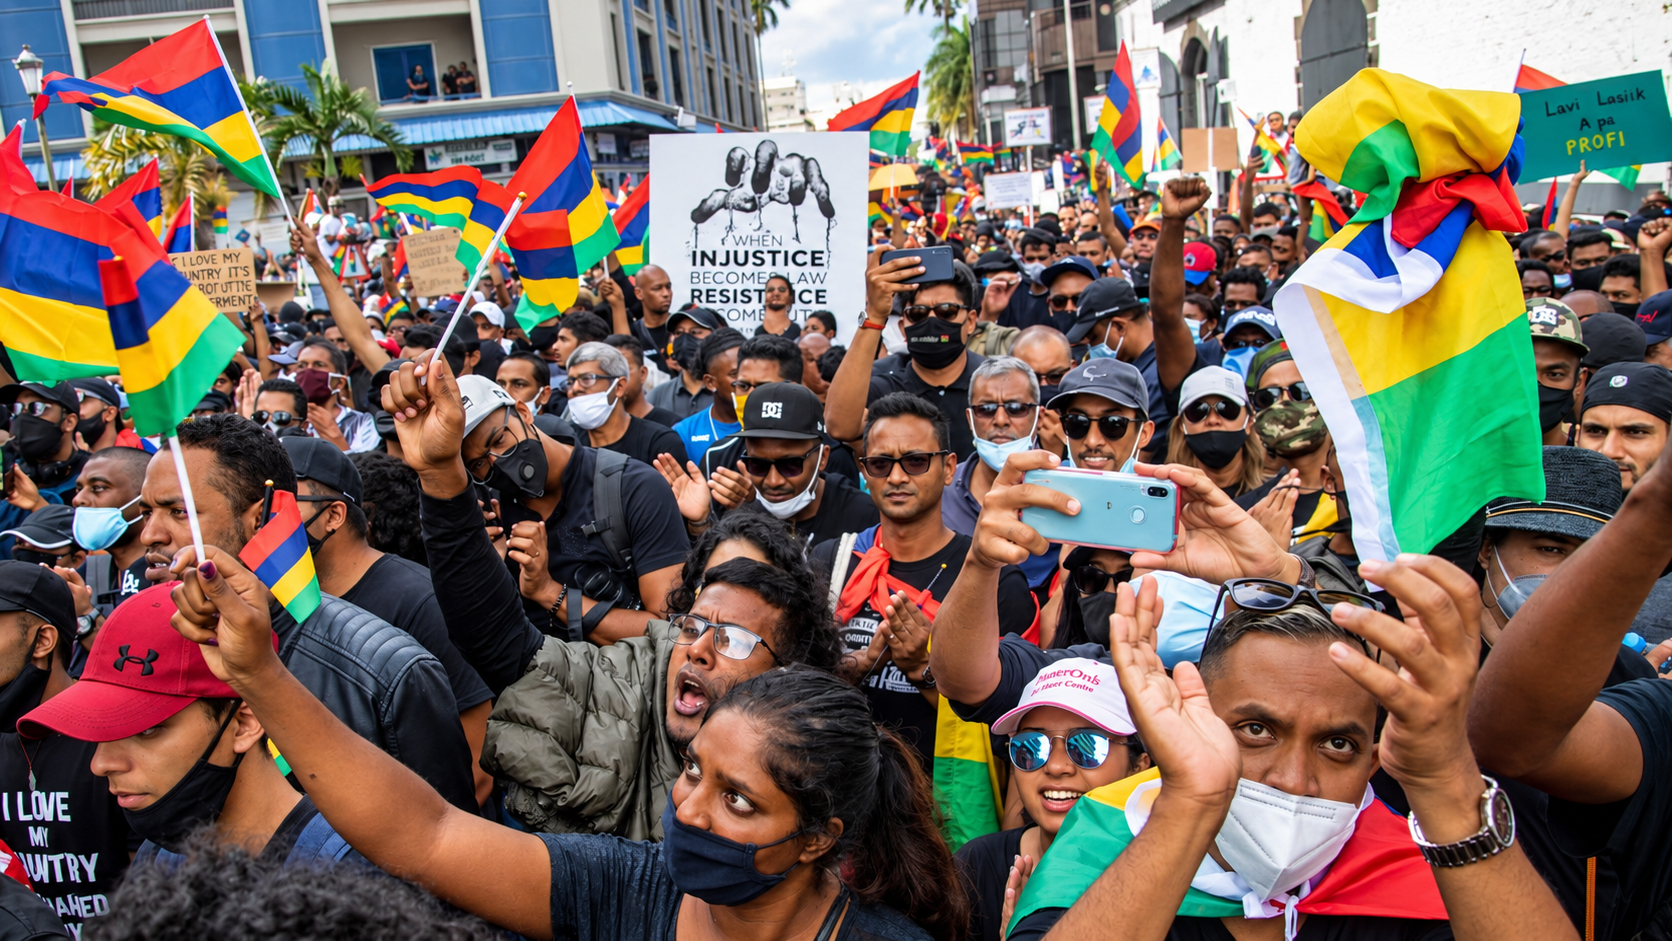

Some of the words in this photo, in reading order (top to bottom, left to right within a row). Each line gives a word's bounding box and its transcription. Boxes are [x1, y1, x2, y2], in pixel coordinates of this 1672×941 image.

[1545, 98, 1580, 117] Lavi
[1597, 87, 1646, 106] Lasiik
[1579, 118, 1591, 131] A
[1597, 116, 1615, 132] pa
[1566, 131, 1625, 156] PROFI
[733, 235, 783, 247] WHEN
[182, 256, 186, 267] I
[190, 254, 217, 266] LOVE
[223, 252, 241, 263] MY
[691, 250, 825, 267] INJUSTICE
[180, 268, 221, 281] UNTRY
[228, 265, 250, 278] IT'S
[788, 272, 827, 285] LAW
[691, 288, 827, 304] RESISTCE
[761, 402, 783, 419] DC
[2, 792, 11, 821] I
[17, 790, 71, 822] LOVE
[28, 826, 49, 848] MY
[13, 852, 99, 883] UNTRY
